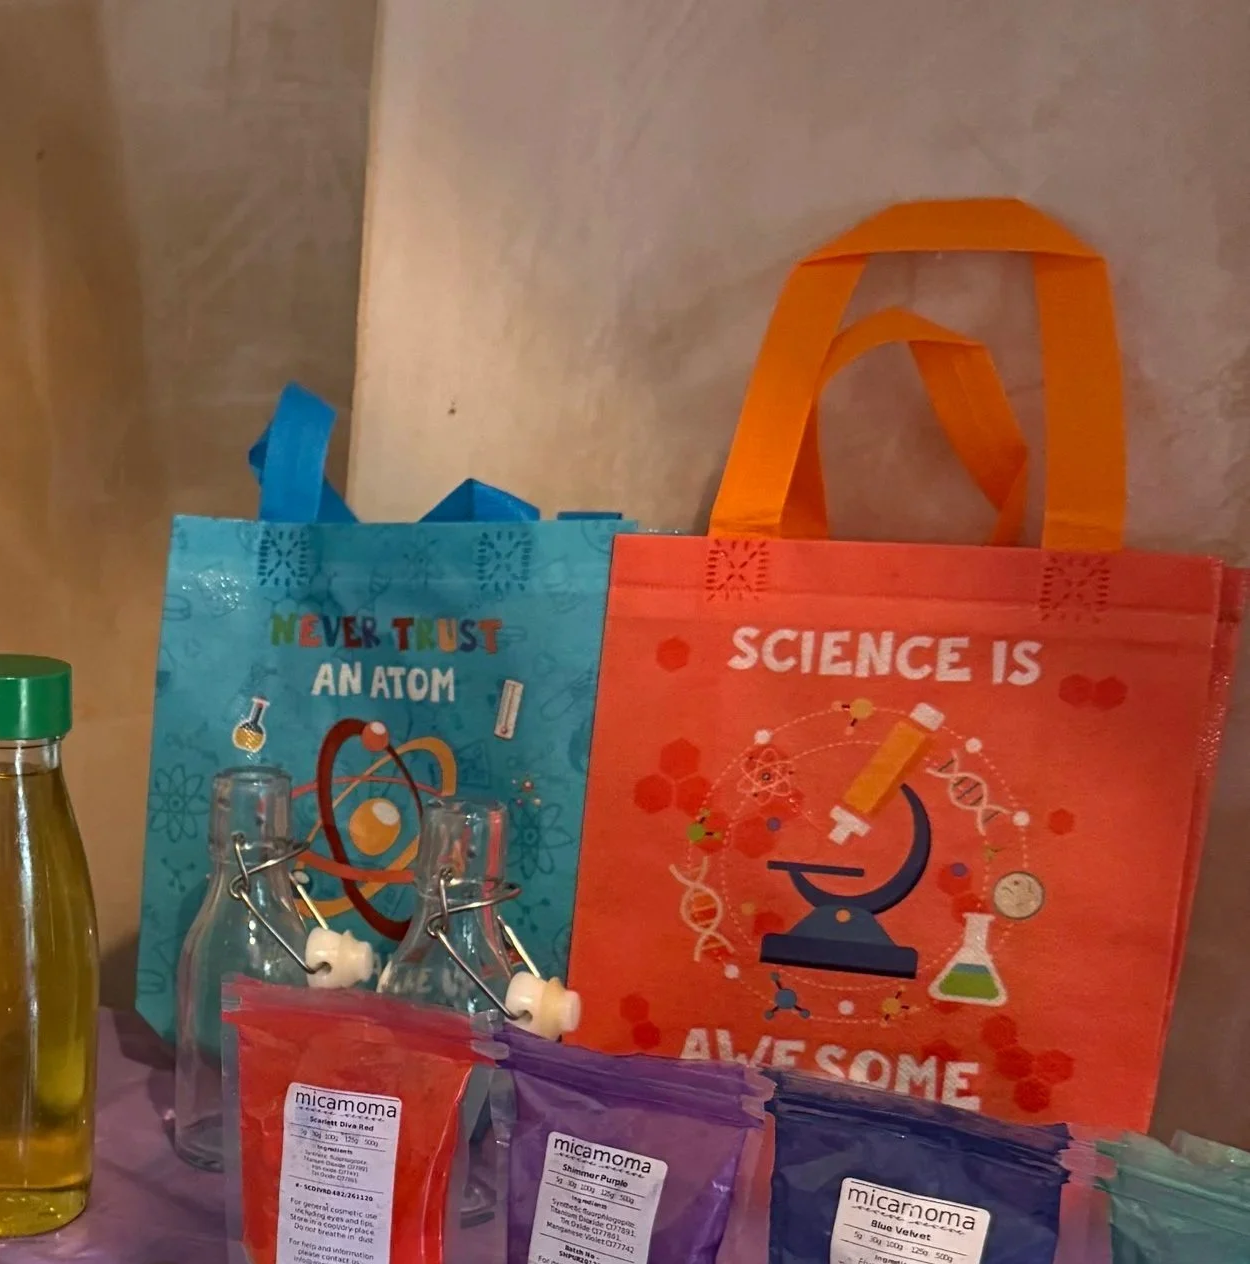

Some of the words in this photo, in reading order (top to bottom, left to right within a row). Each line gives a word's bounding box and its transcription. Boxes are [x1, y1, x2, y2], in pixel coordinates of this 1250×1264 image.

[271, 613, 380, 649] NEVER
[393, 617, 502, 653] TRUST
[728, 626, 972, 683] SCIENCE
[992, 640, 1043, 686] IS
[312, 662, 362, 697] AN
[370, 664, 455, 702] ATOM
[295, 1090, 396, 1118] micamoma
[309, 1115, 337, 1126] Scarlett
[339, 1120, 357, 1129] Diva
[358, 1123, 374, 1131] Red
[553, 1137, 651, 1173] micamoma
[561, 1163, 599, 1179] Shimmer
[599, 1173, 628, 1188] Purple
[847, 1187, 975, 1230] micamoma
[870, 1219, 892, 1232] Blue
[895, 1225, 930, 1241] Velvet
